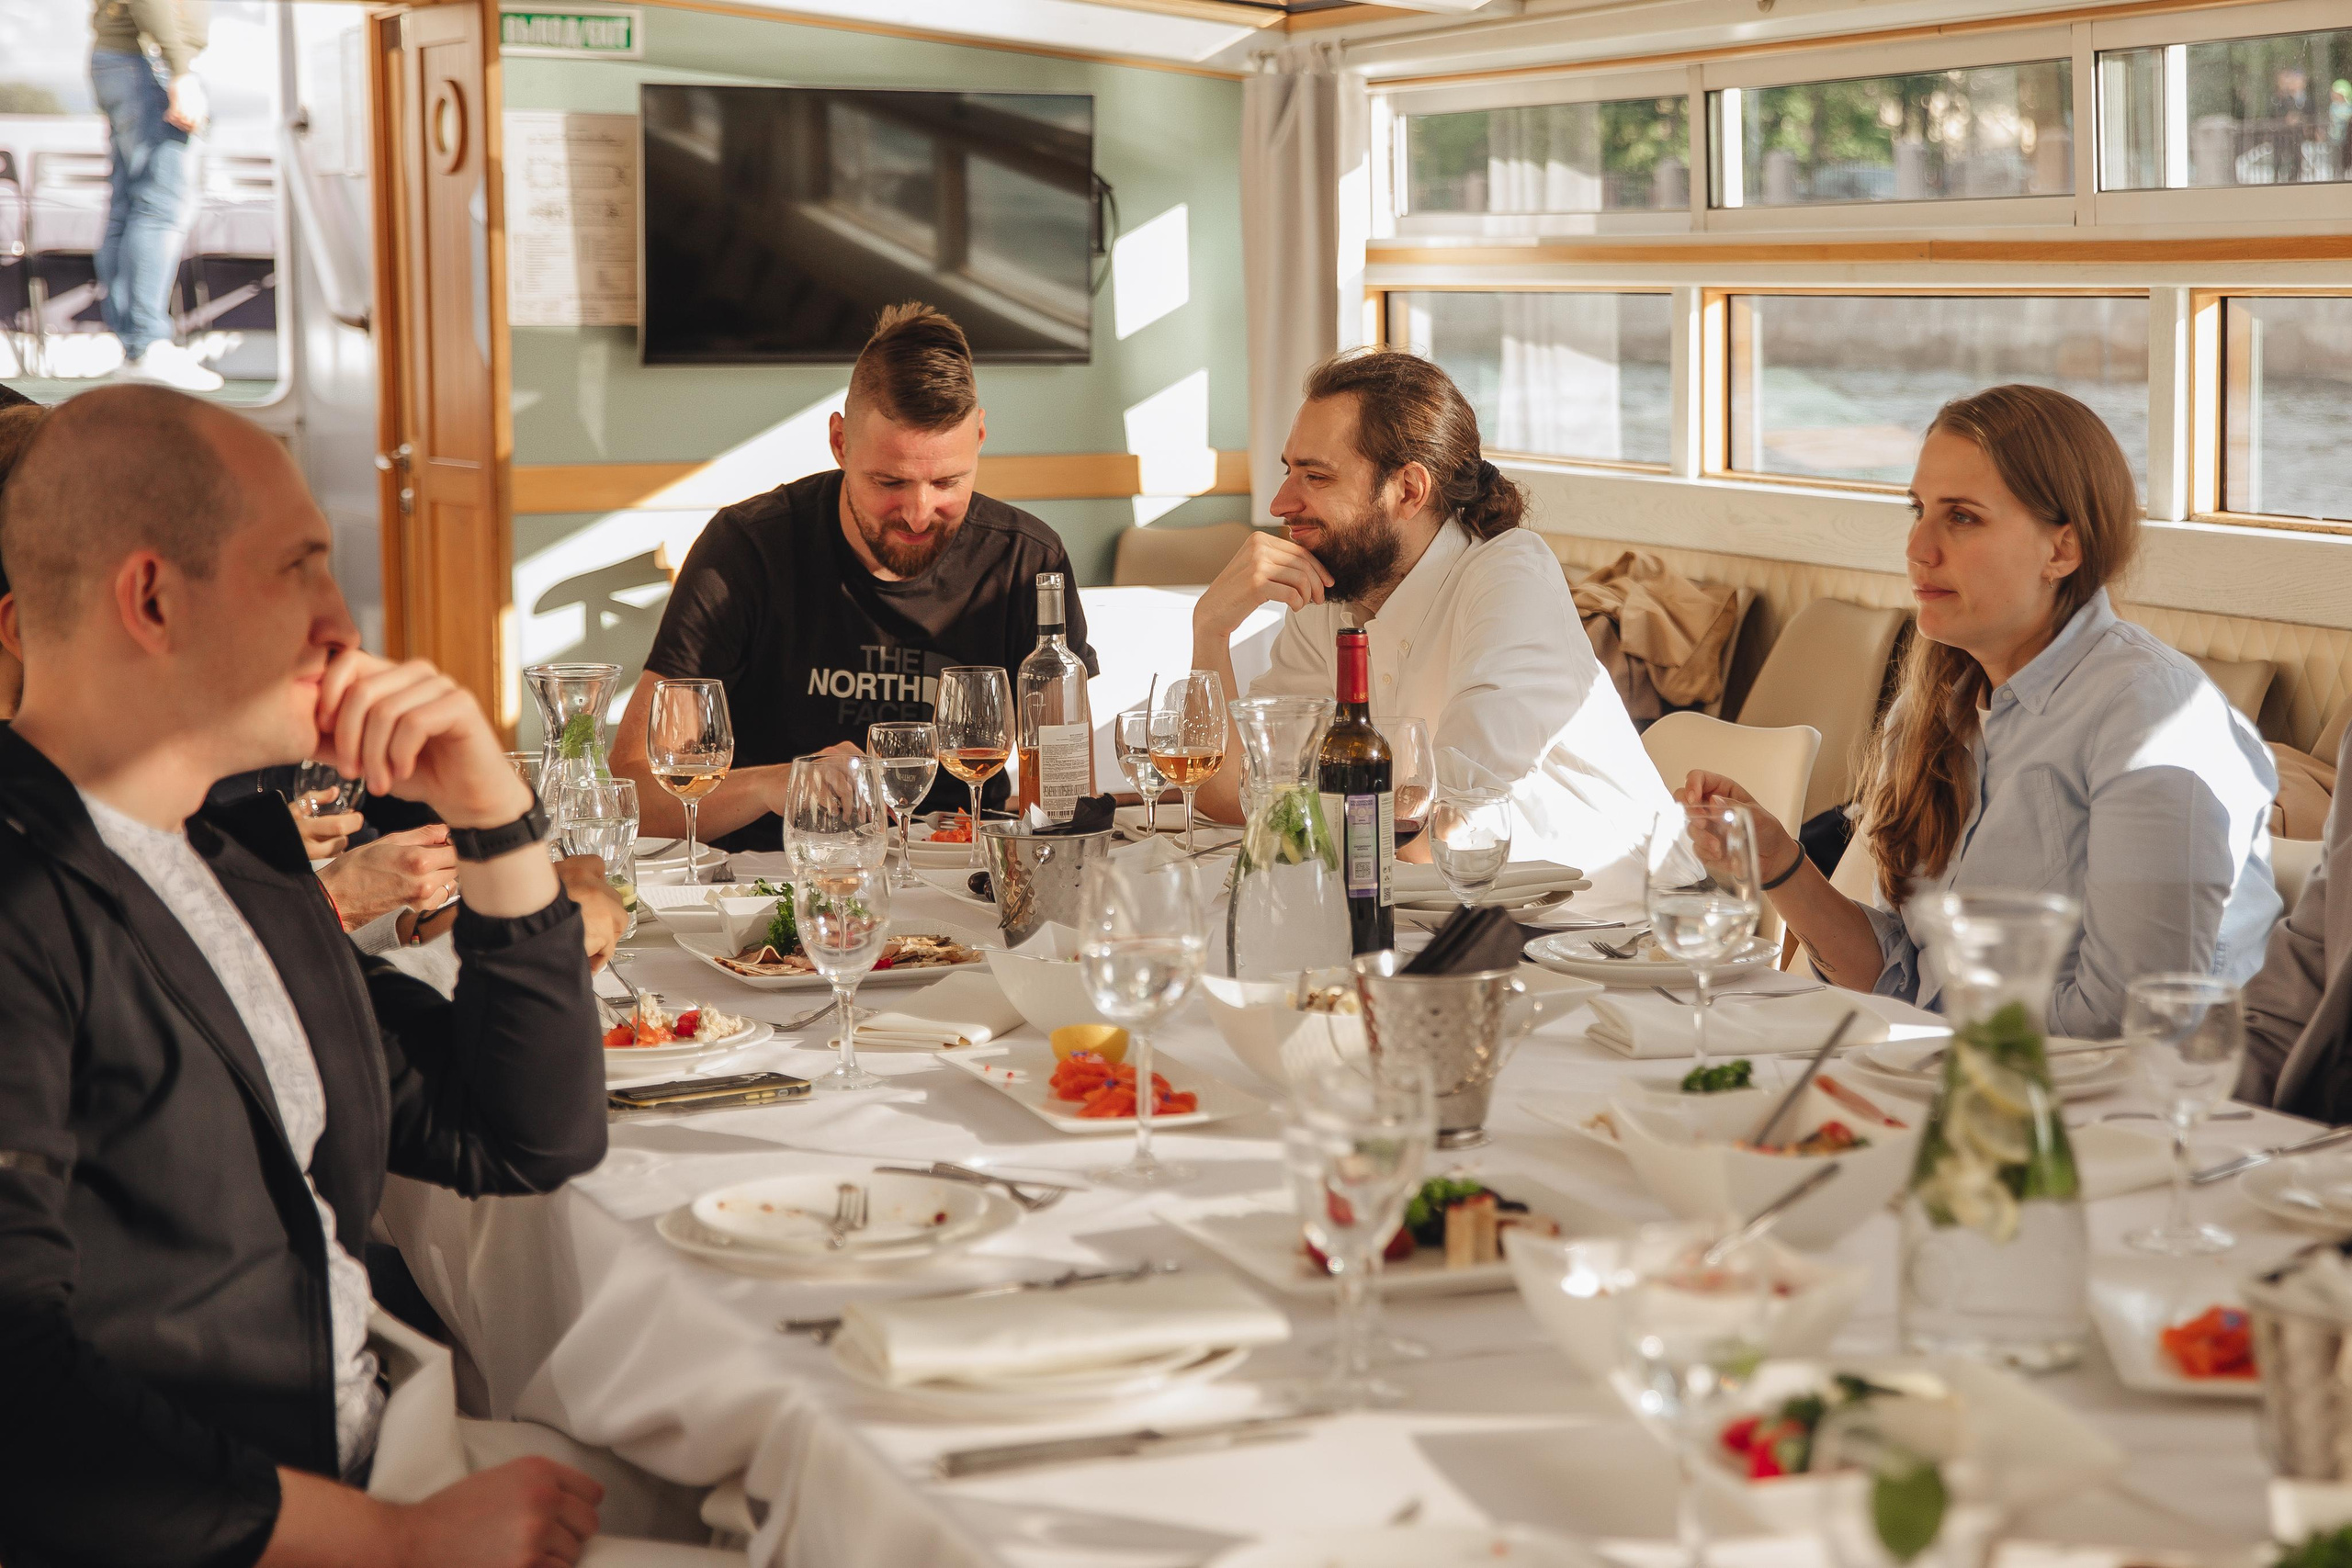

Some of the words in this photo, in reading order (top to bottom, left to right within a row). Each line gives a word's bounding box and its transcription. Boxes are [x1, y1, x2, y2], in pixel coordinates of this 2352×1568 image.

[860, 645, 922, 673] THE
[808, 668, 921, 702] NORTH
[837, 699, 918, 726] FACE
